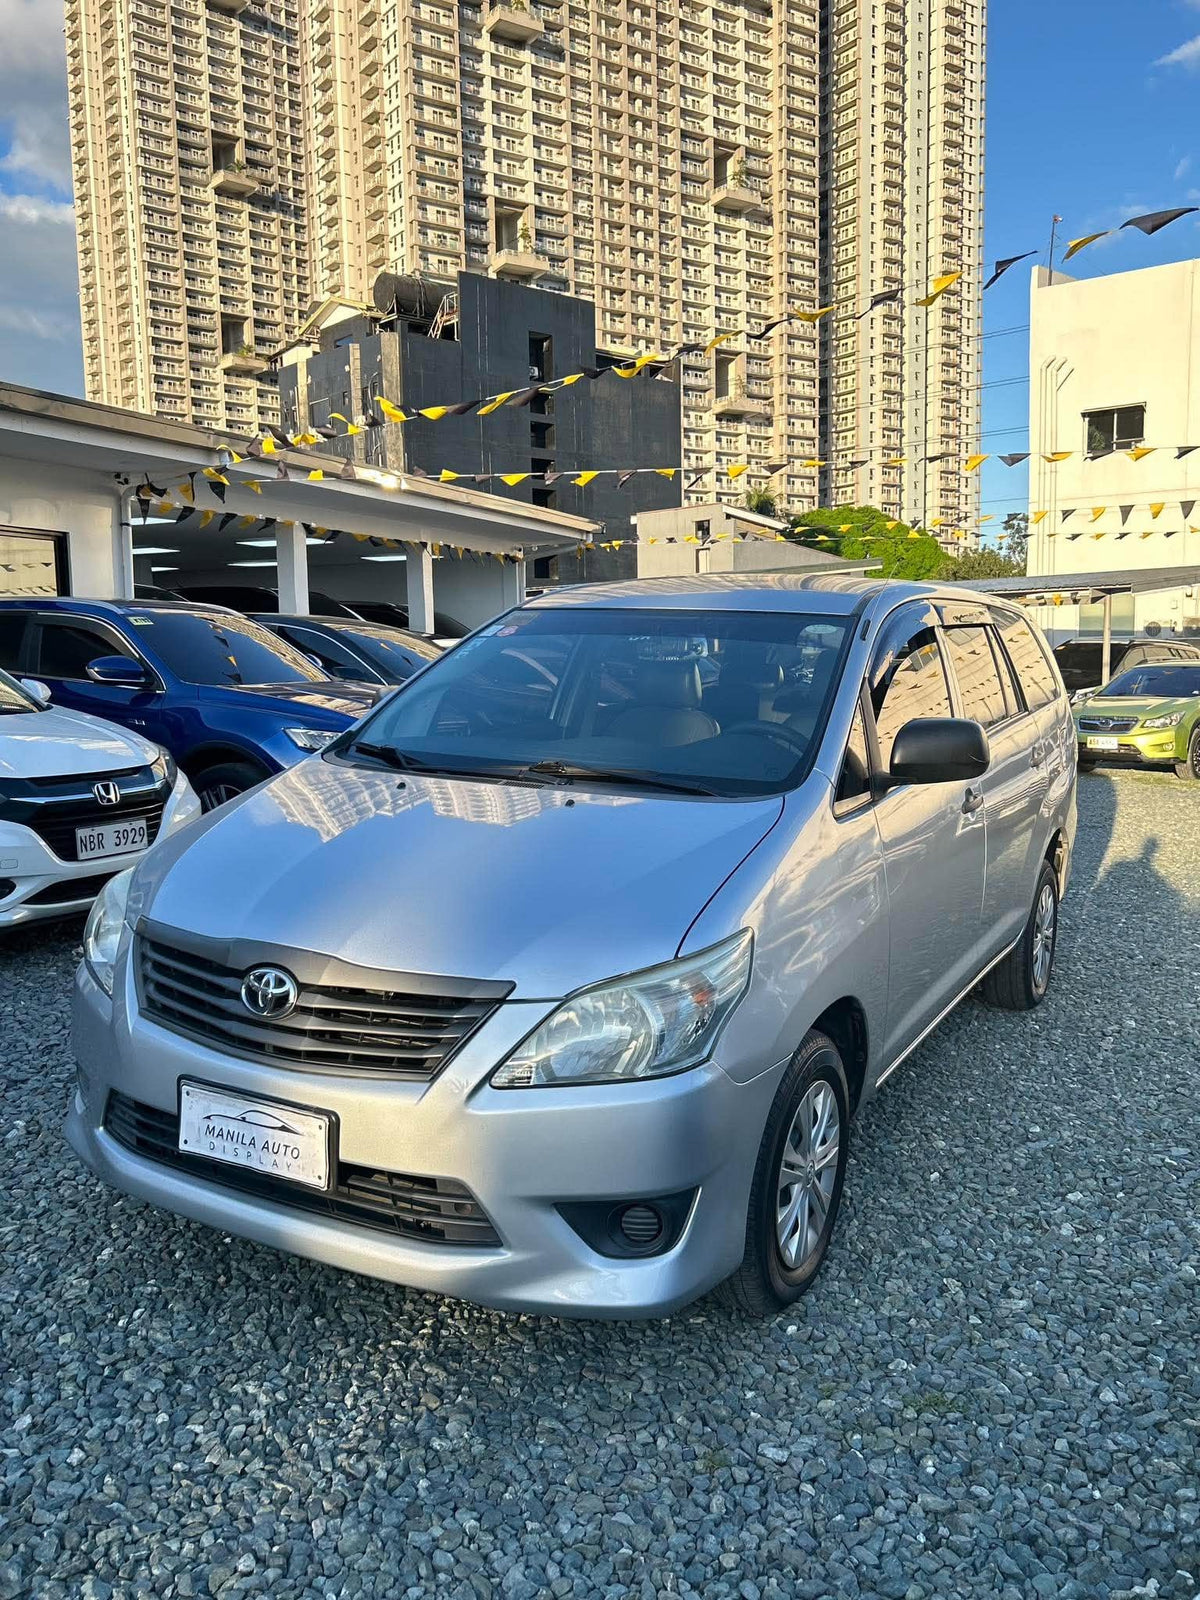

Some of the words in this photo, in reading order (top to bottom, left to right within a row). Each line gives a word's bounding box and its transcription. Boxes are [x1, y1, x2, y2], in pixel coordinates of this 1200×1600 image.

[79, 832, 105, 854] NBR
[113, 826, 146, 847] 3929
[204, 1124, 256, 1149] MANILA
[261, 1140, 300, 1160] AUTO
[209, 1141, 292, 1171] DISPLAY
